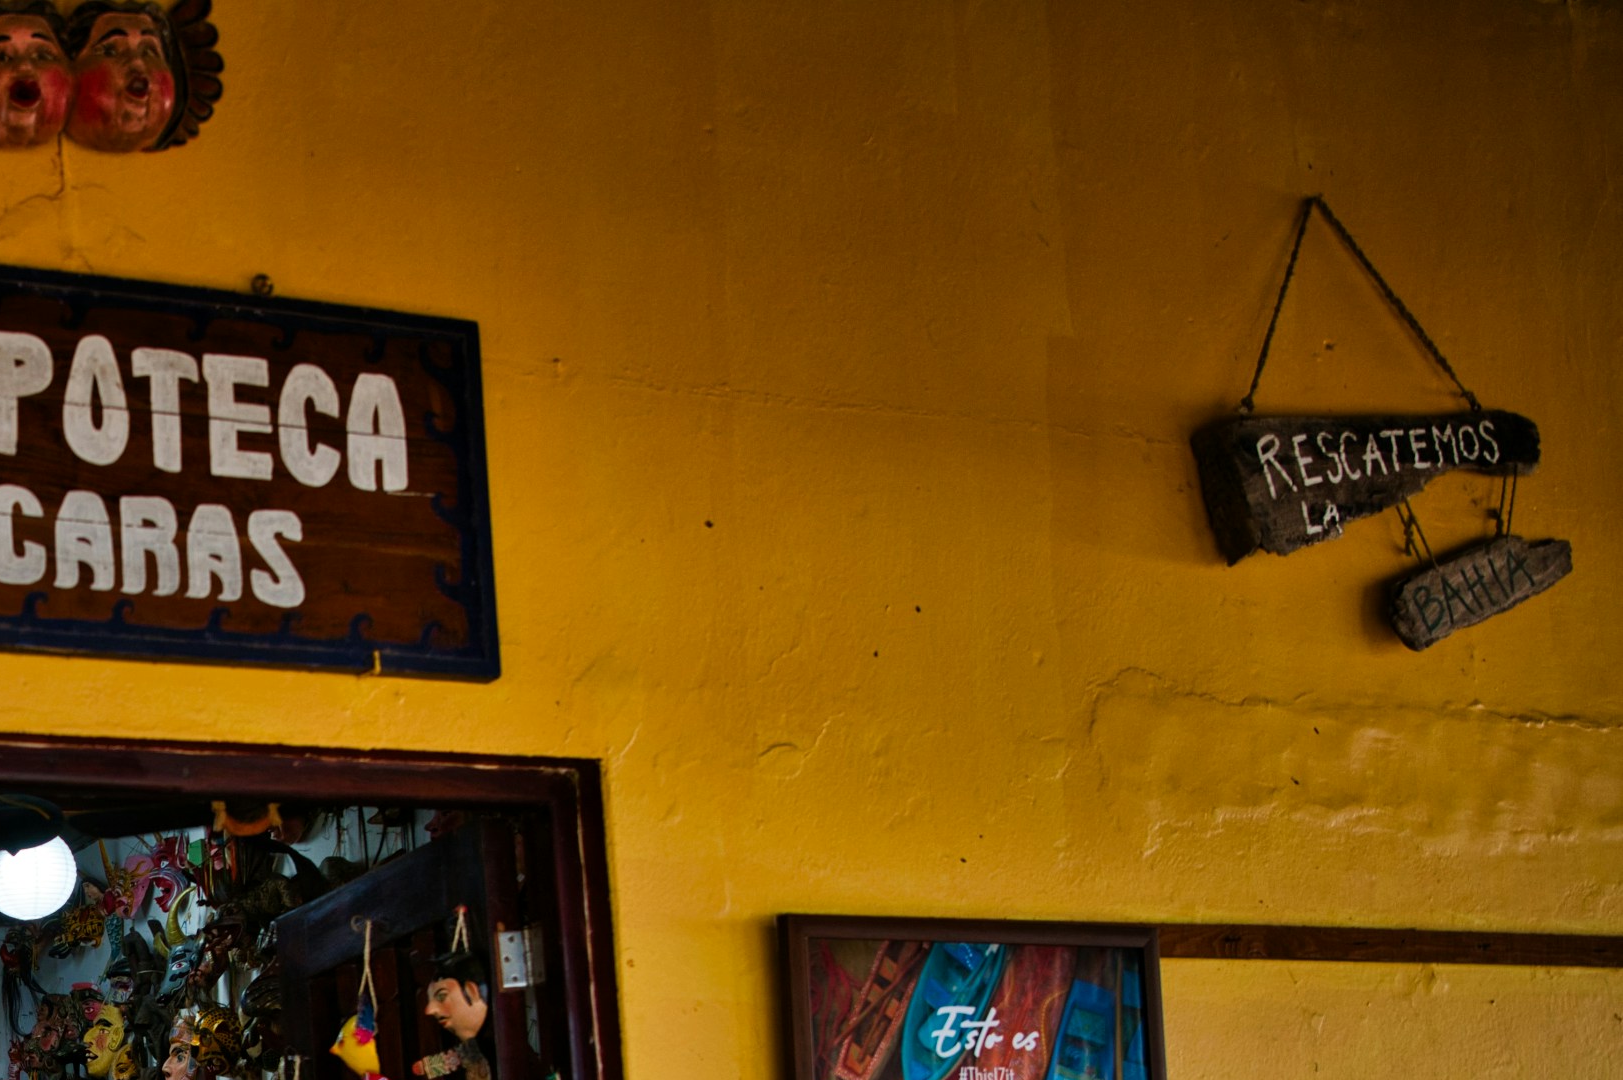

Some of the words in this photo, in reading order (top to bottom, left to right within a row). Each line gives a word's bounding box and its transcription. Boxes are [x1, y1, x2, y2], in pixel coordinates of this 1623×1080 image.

[1256, 420, 1500, 499] RESCATEMOS
[1301, 500, 1343, 535] LA
[1412, 550, 1536, 635] BAHIA
[931, 1005, 1004, 1058] Esto
[1011, 1030, 1040, 1051] es
